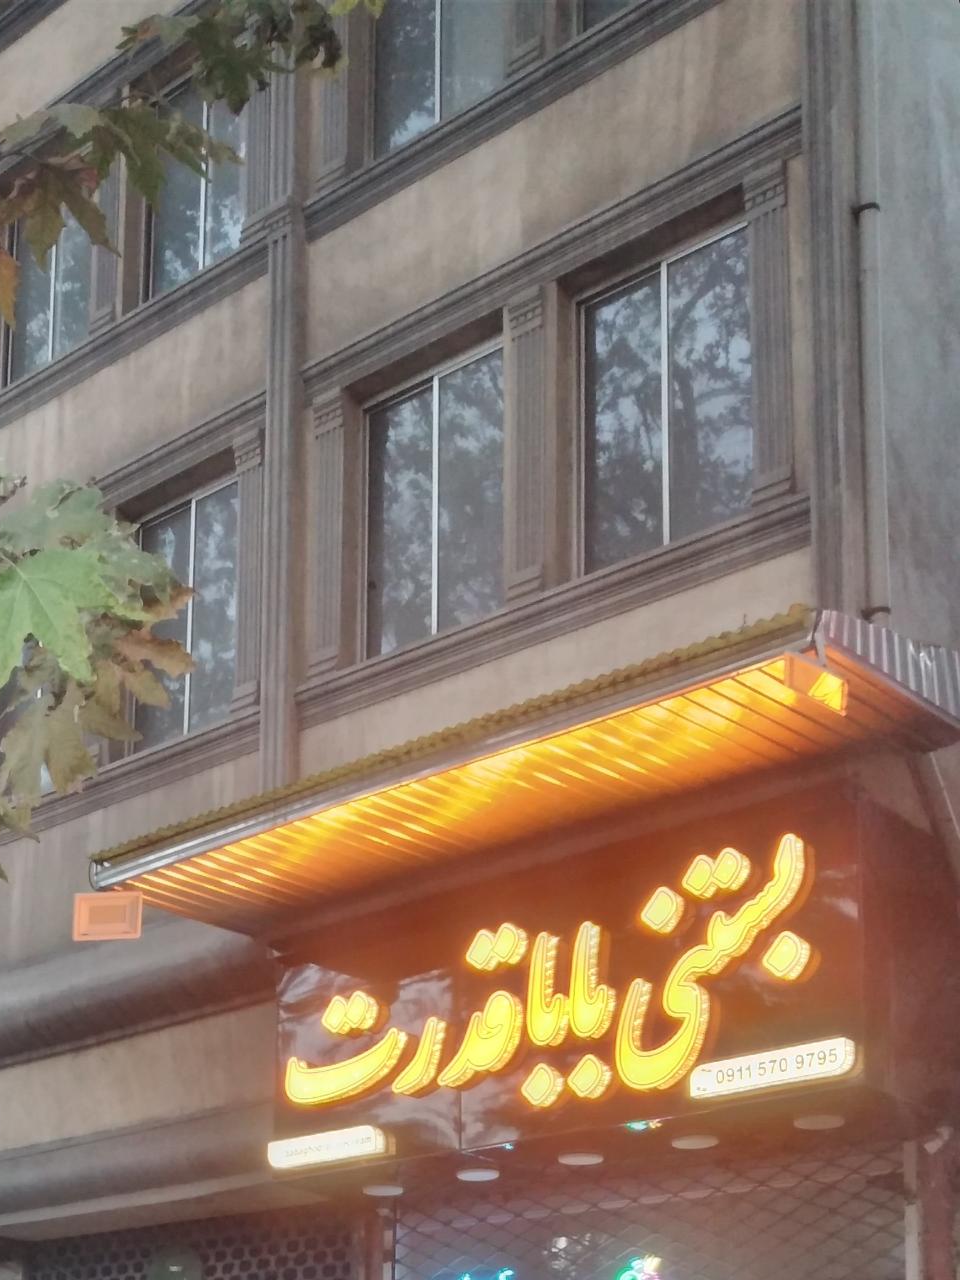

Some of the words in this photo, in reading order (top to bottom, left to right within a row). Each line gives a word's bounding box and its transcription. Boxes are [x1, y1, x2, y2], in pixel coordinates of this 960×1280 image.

[615, 831, 815, 1091] بستنی
[715, 1065, 752, 1085] 0911
[757, 1057, 789, 1077] 570
[795, 1047, 838, 1070] 9795
